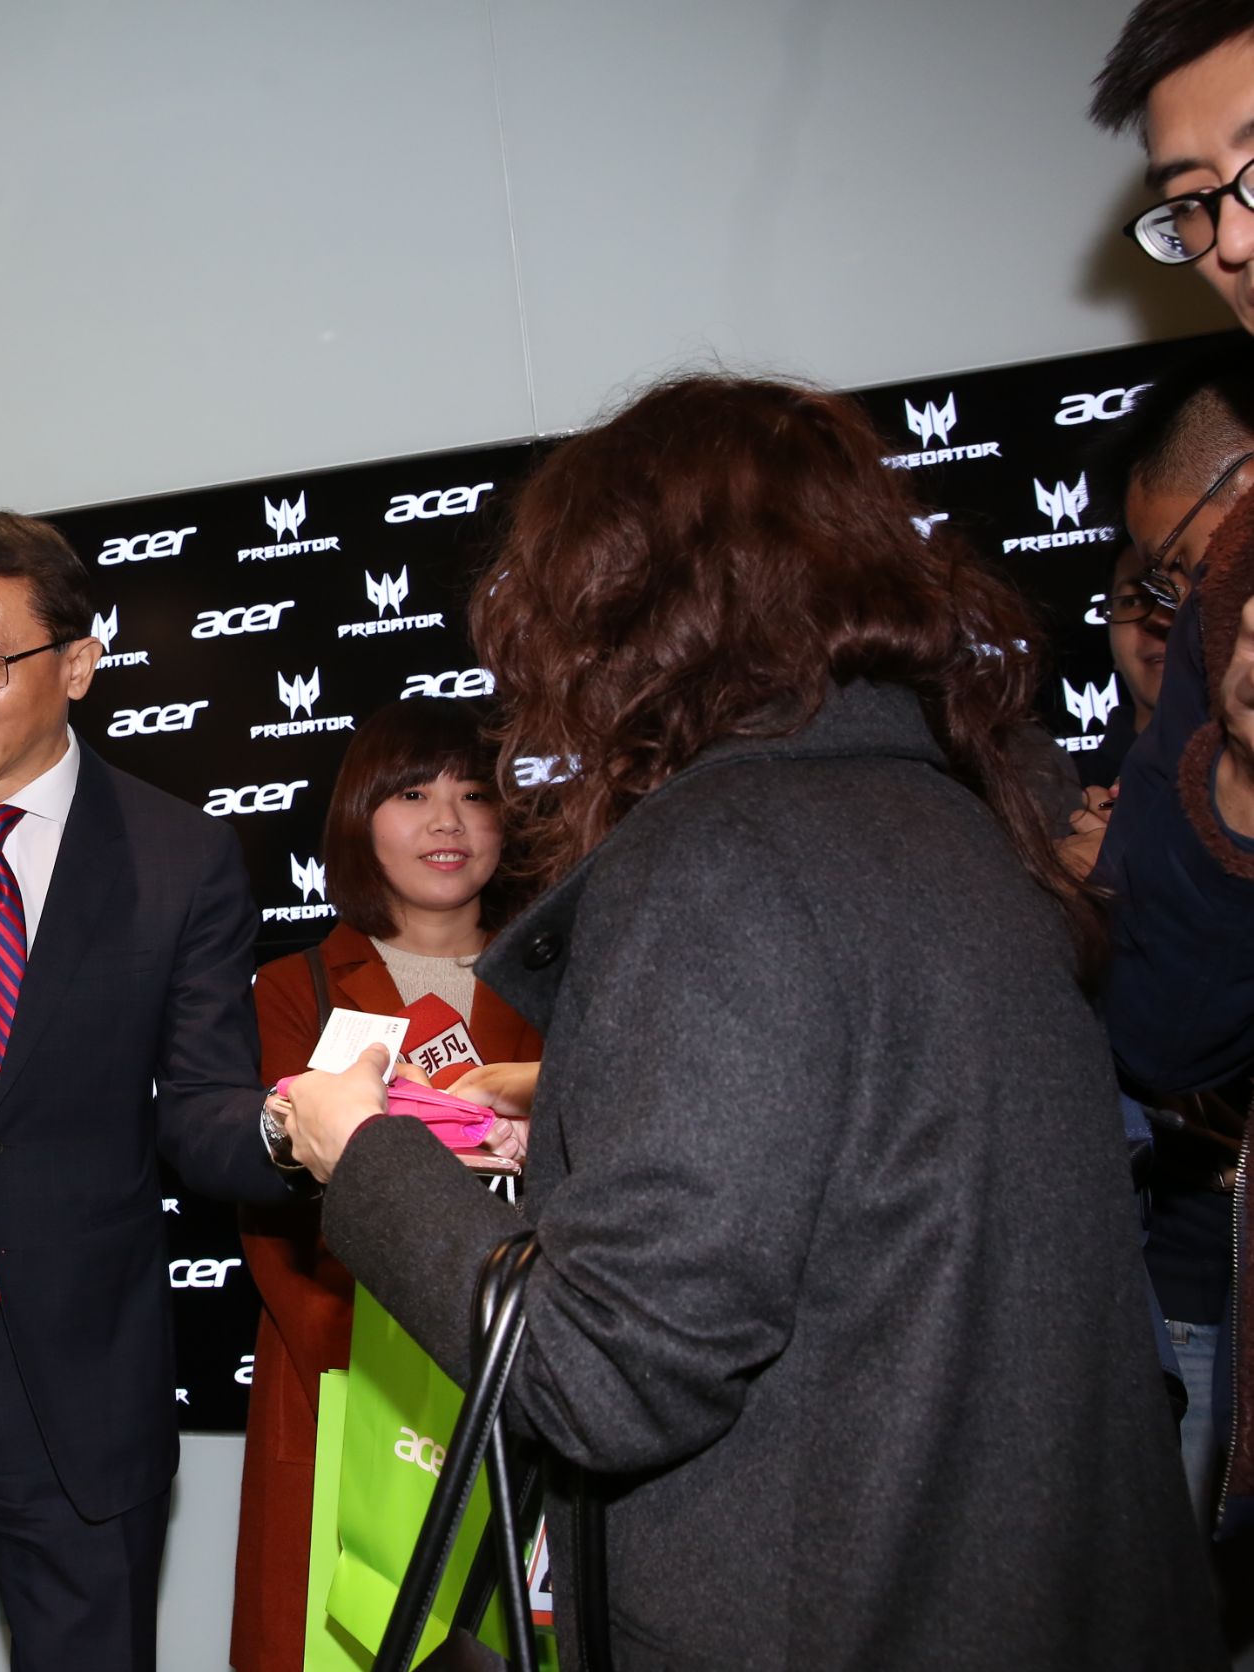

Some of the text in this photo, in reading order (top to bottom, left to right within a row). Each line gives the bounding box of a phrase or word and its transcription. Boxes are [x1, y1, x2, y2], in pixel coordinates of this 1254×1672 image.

[1054, 383, 1154, 425] ac
[384, 482, 494, 523] acer
[97, 526, 198, 566] acer
[237, 536, 341, 562] PREDATOR
[1002, 526, 1115, 554] PREDATO
[191, 600, 296, 639] acer
[337, 612, 445, 638] PREDATOR
[95, 650, 150, 670] ATOR
[107, 700, 209, 738] acer
[250, 715, 356, 739] PREDATOR
[202, 779, 309, 817] acer
[419, 1033, 467, 1074] 非凡
[168, 1258, 242, 1288] cer
[394, 1426, 446, 1479] ace
